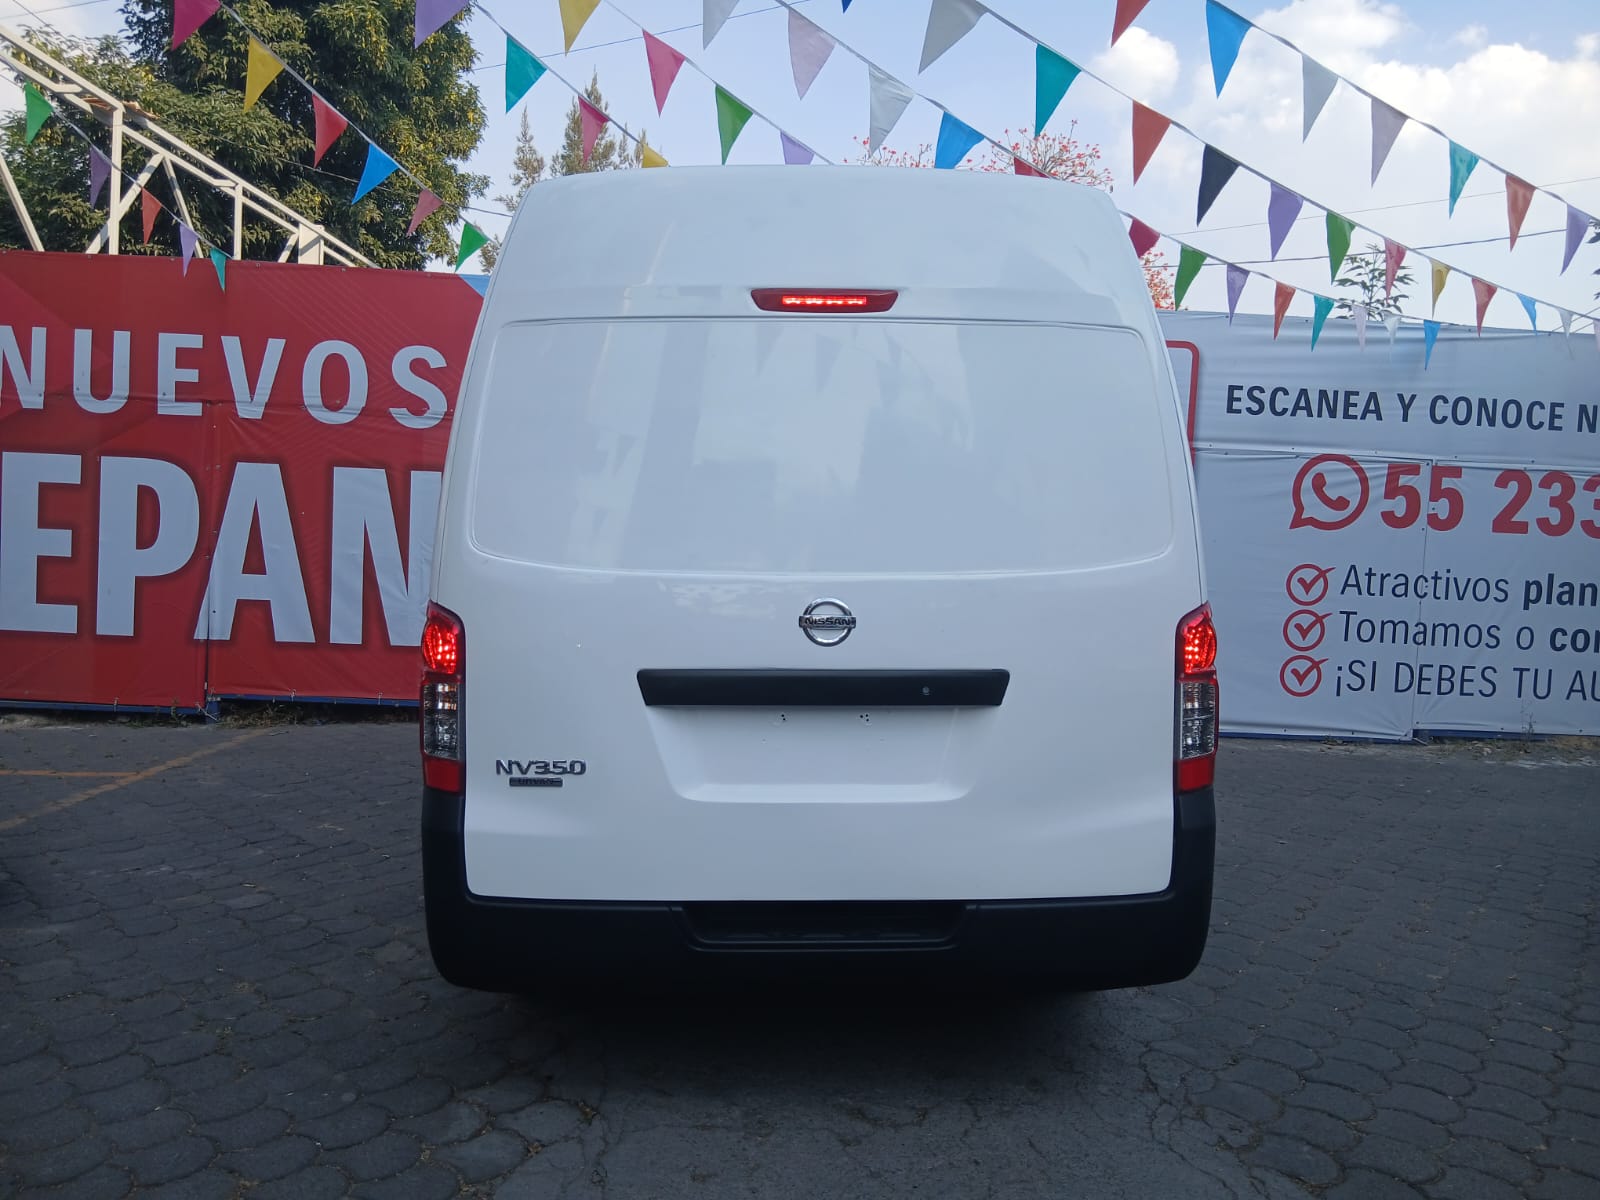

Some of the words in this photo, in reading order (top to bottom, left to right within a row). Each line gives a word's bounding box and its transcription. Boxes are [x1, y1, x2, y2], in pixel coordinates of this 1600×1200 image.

[0, 325, 448, 429] NUEVOS
[1226, 384, 1383, 422] ESCANEA
[1397, 393, 1417, 423] Y
[1429, 394, 1565, 432] CONOCE
[1577, 403, 1598, 434] N
[1380, 463, 1464, 532] 55
[0, 451, 443, 647] EPAN
[1340, 564, 1509, 602] Atractivos
[1523, 573, 1598, 611] plan
[804, 616, 851, 626] NISSAN
[1339, 610, 1501, 649] Tomamos
[1516, 626, 1535, 651] o
[1335, 660, 1377, 697] ¡SI
[1394, 662, 1498, 698] DEBES
[1513, 667, 1553, 700] TU
[495, 759, 587, 776] NV350
